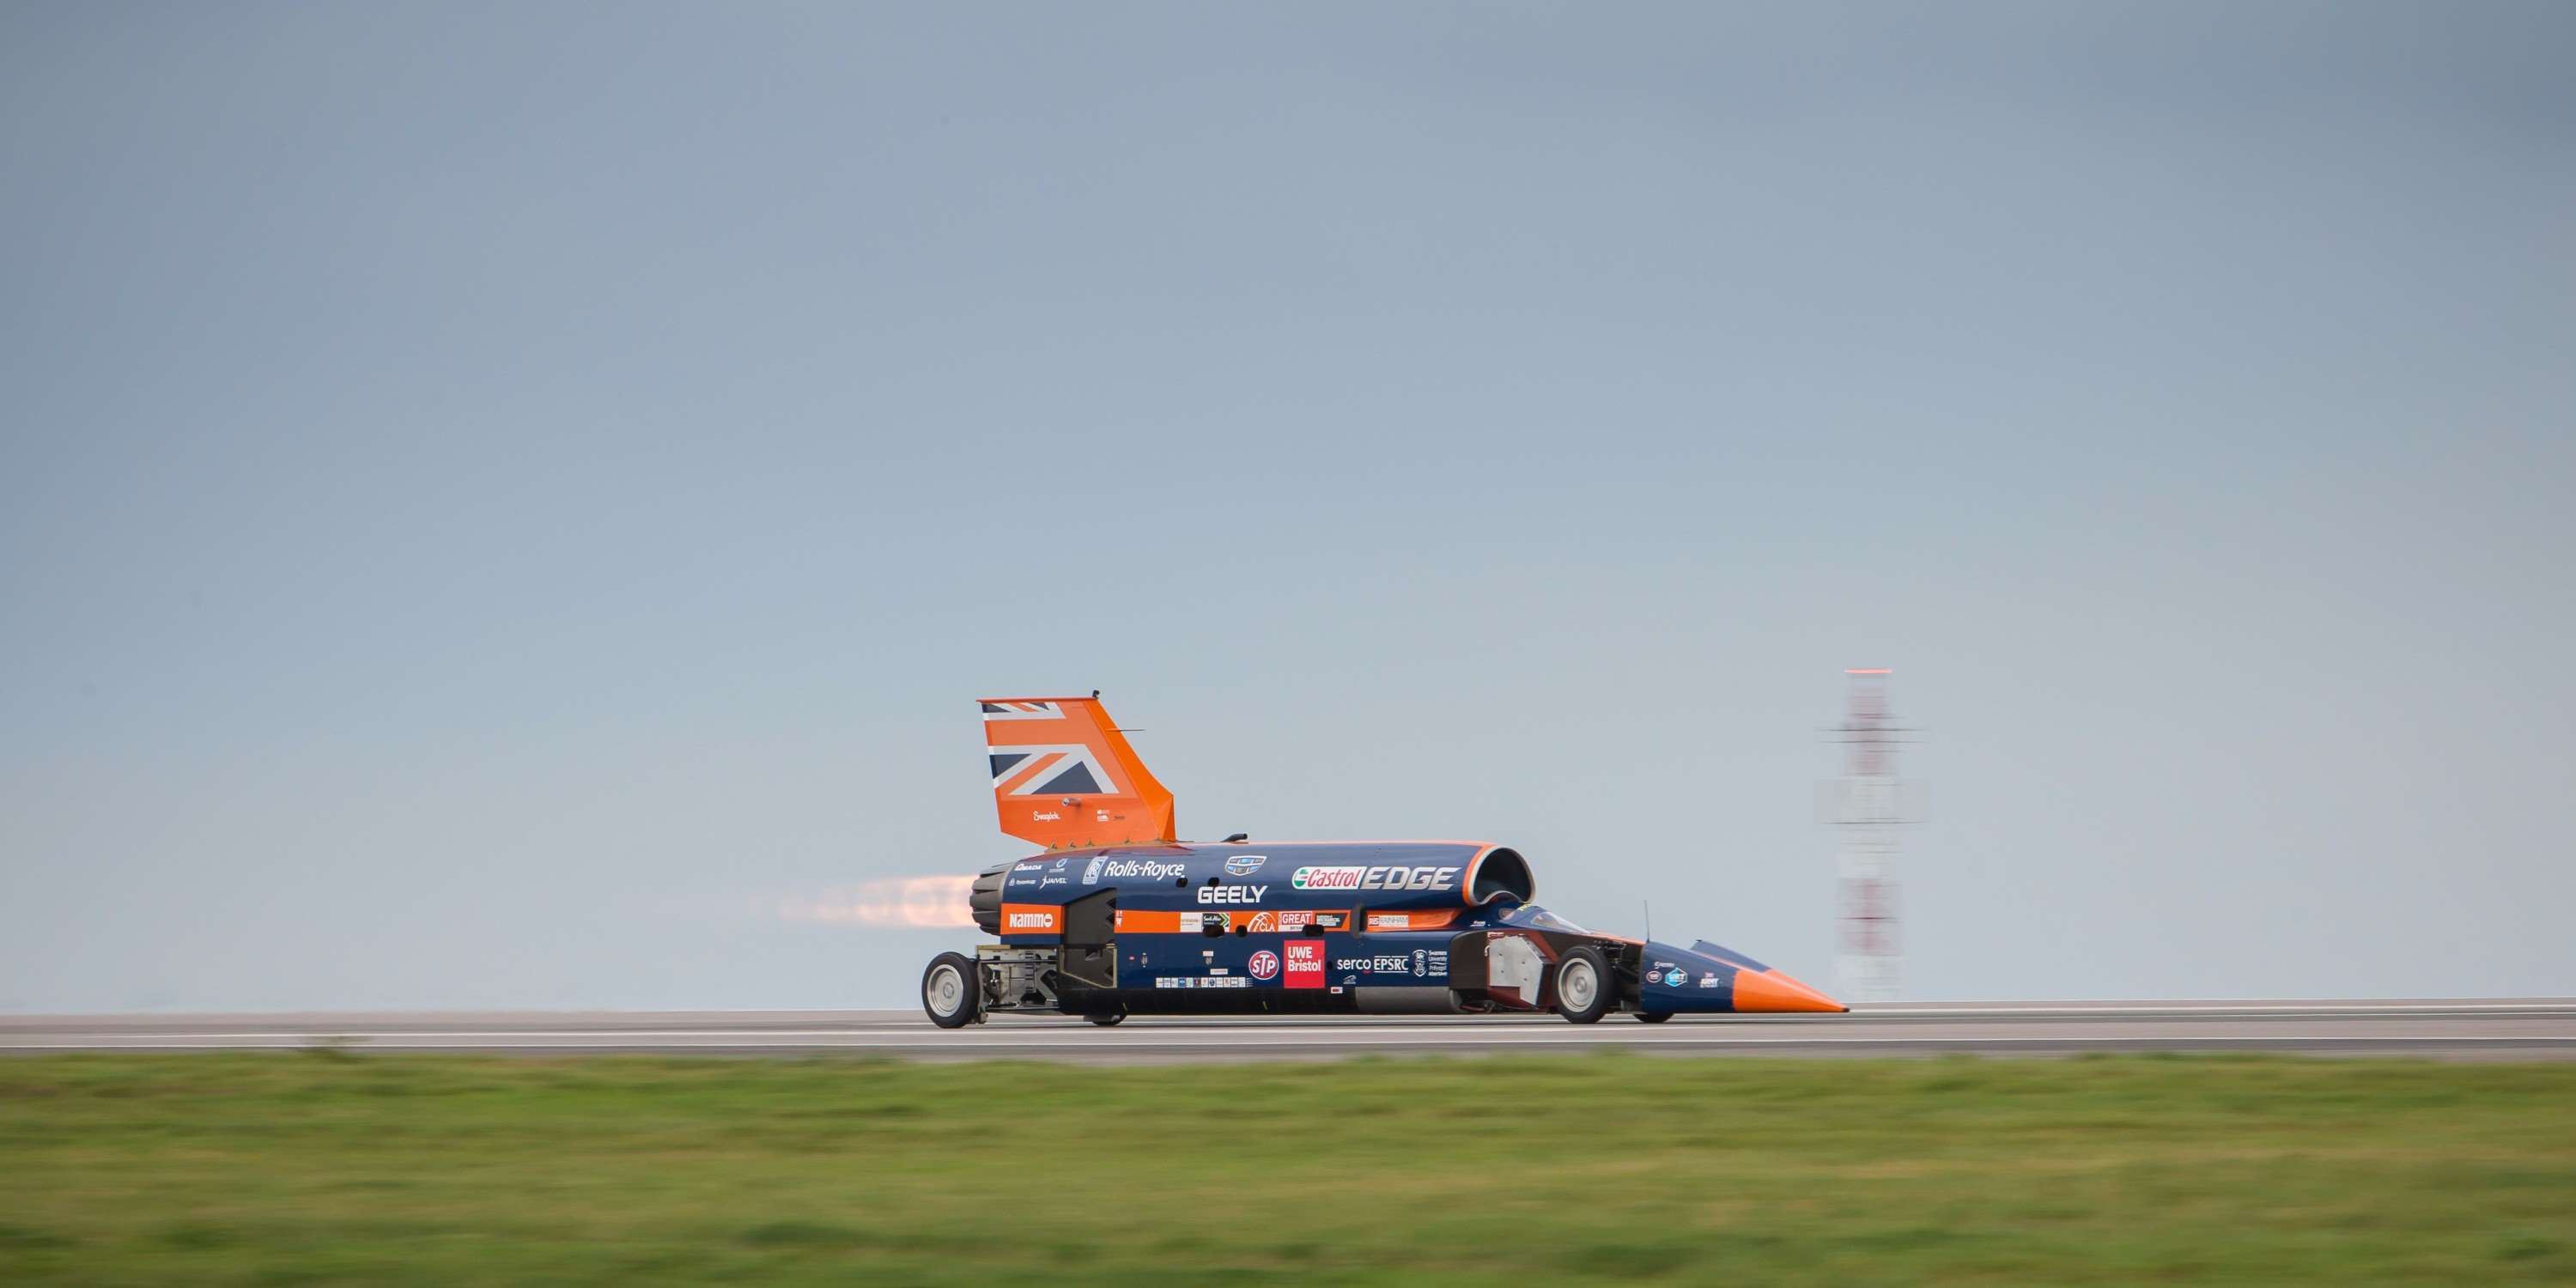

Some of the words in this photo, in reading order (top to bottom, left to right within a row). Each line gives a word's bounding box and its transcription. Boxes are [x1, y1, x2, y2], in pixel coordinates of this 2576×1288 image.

[1104, 860, 1185, 881] Rolls-Royce
[1307, 868, 1361, 888] Castrol
[1360, 866, 1461, 890] EDGE
[1198, 885, 1268, 904] GEELY
[1282, 913, 1312, 925] GREAT
[1259, 922, 1276, 932] CLA
[1288, 946, 1313, 959] UWE
[1252, 954, 1276, 976] STP
[1288, 959, 1321, 972] Bristol
[1337, 959, 1371, 970] serco
[1374, 958, 1409, 970] EPSRC
